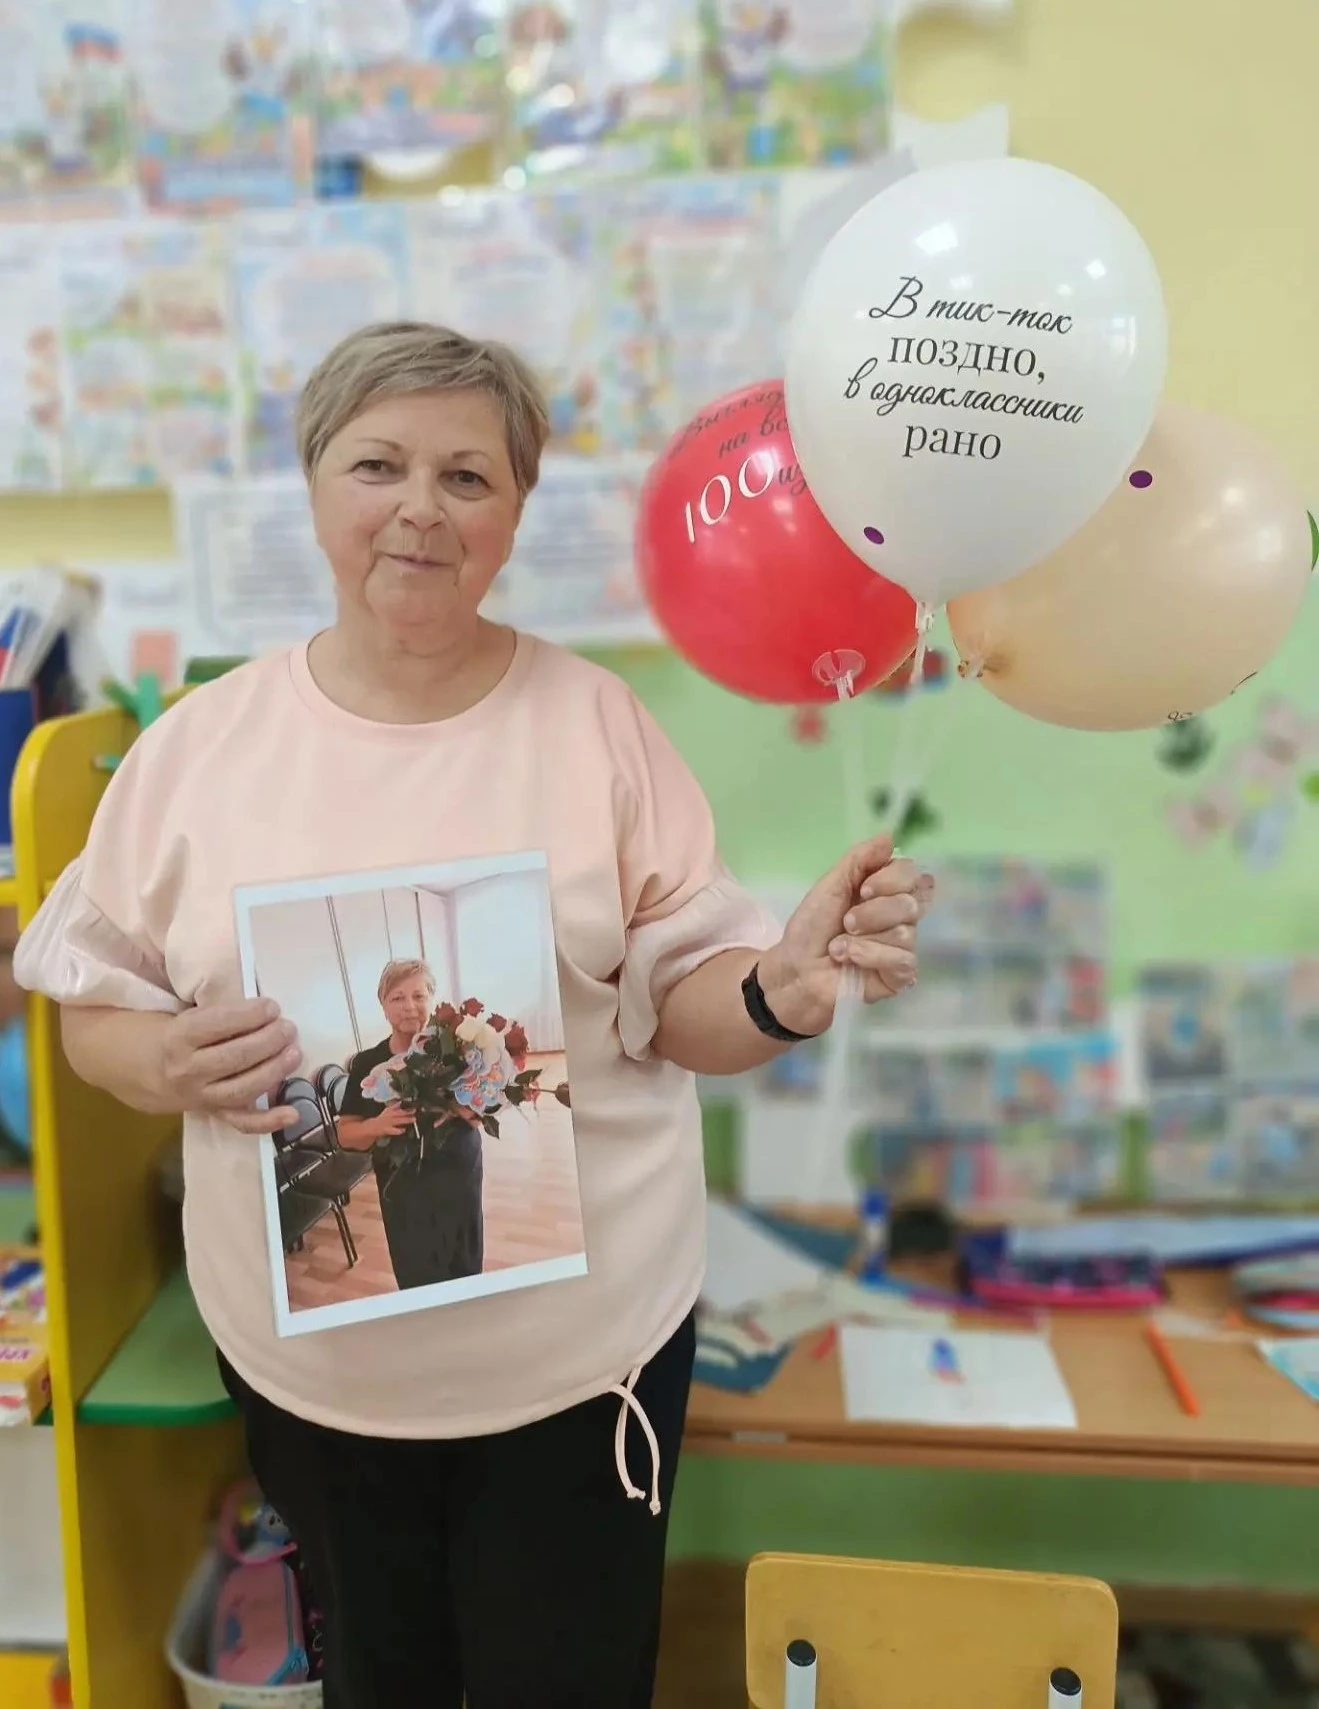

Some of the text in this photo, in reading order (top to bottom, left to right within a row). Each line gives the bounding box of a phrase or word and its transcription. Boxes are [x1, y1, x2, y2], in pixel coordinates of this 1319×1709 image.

[869, 275, 1073, 334] В тик-ток
[887, 336, 1045, 384] поздно,
[844, 357, 1084, 424] в одноклассники
[902, 423, 1002, 460] рано
[684, 450, 775, 544] 100
